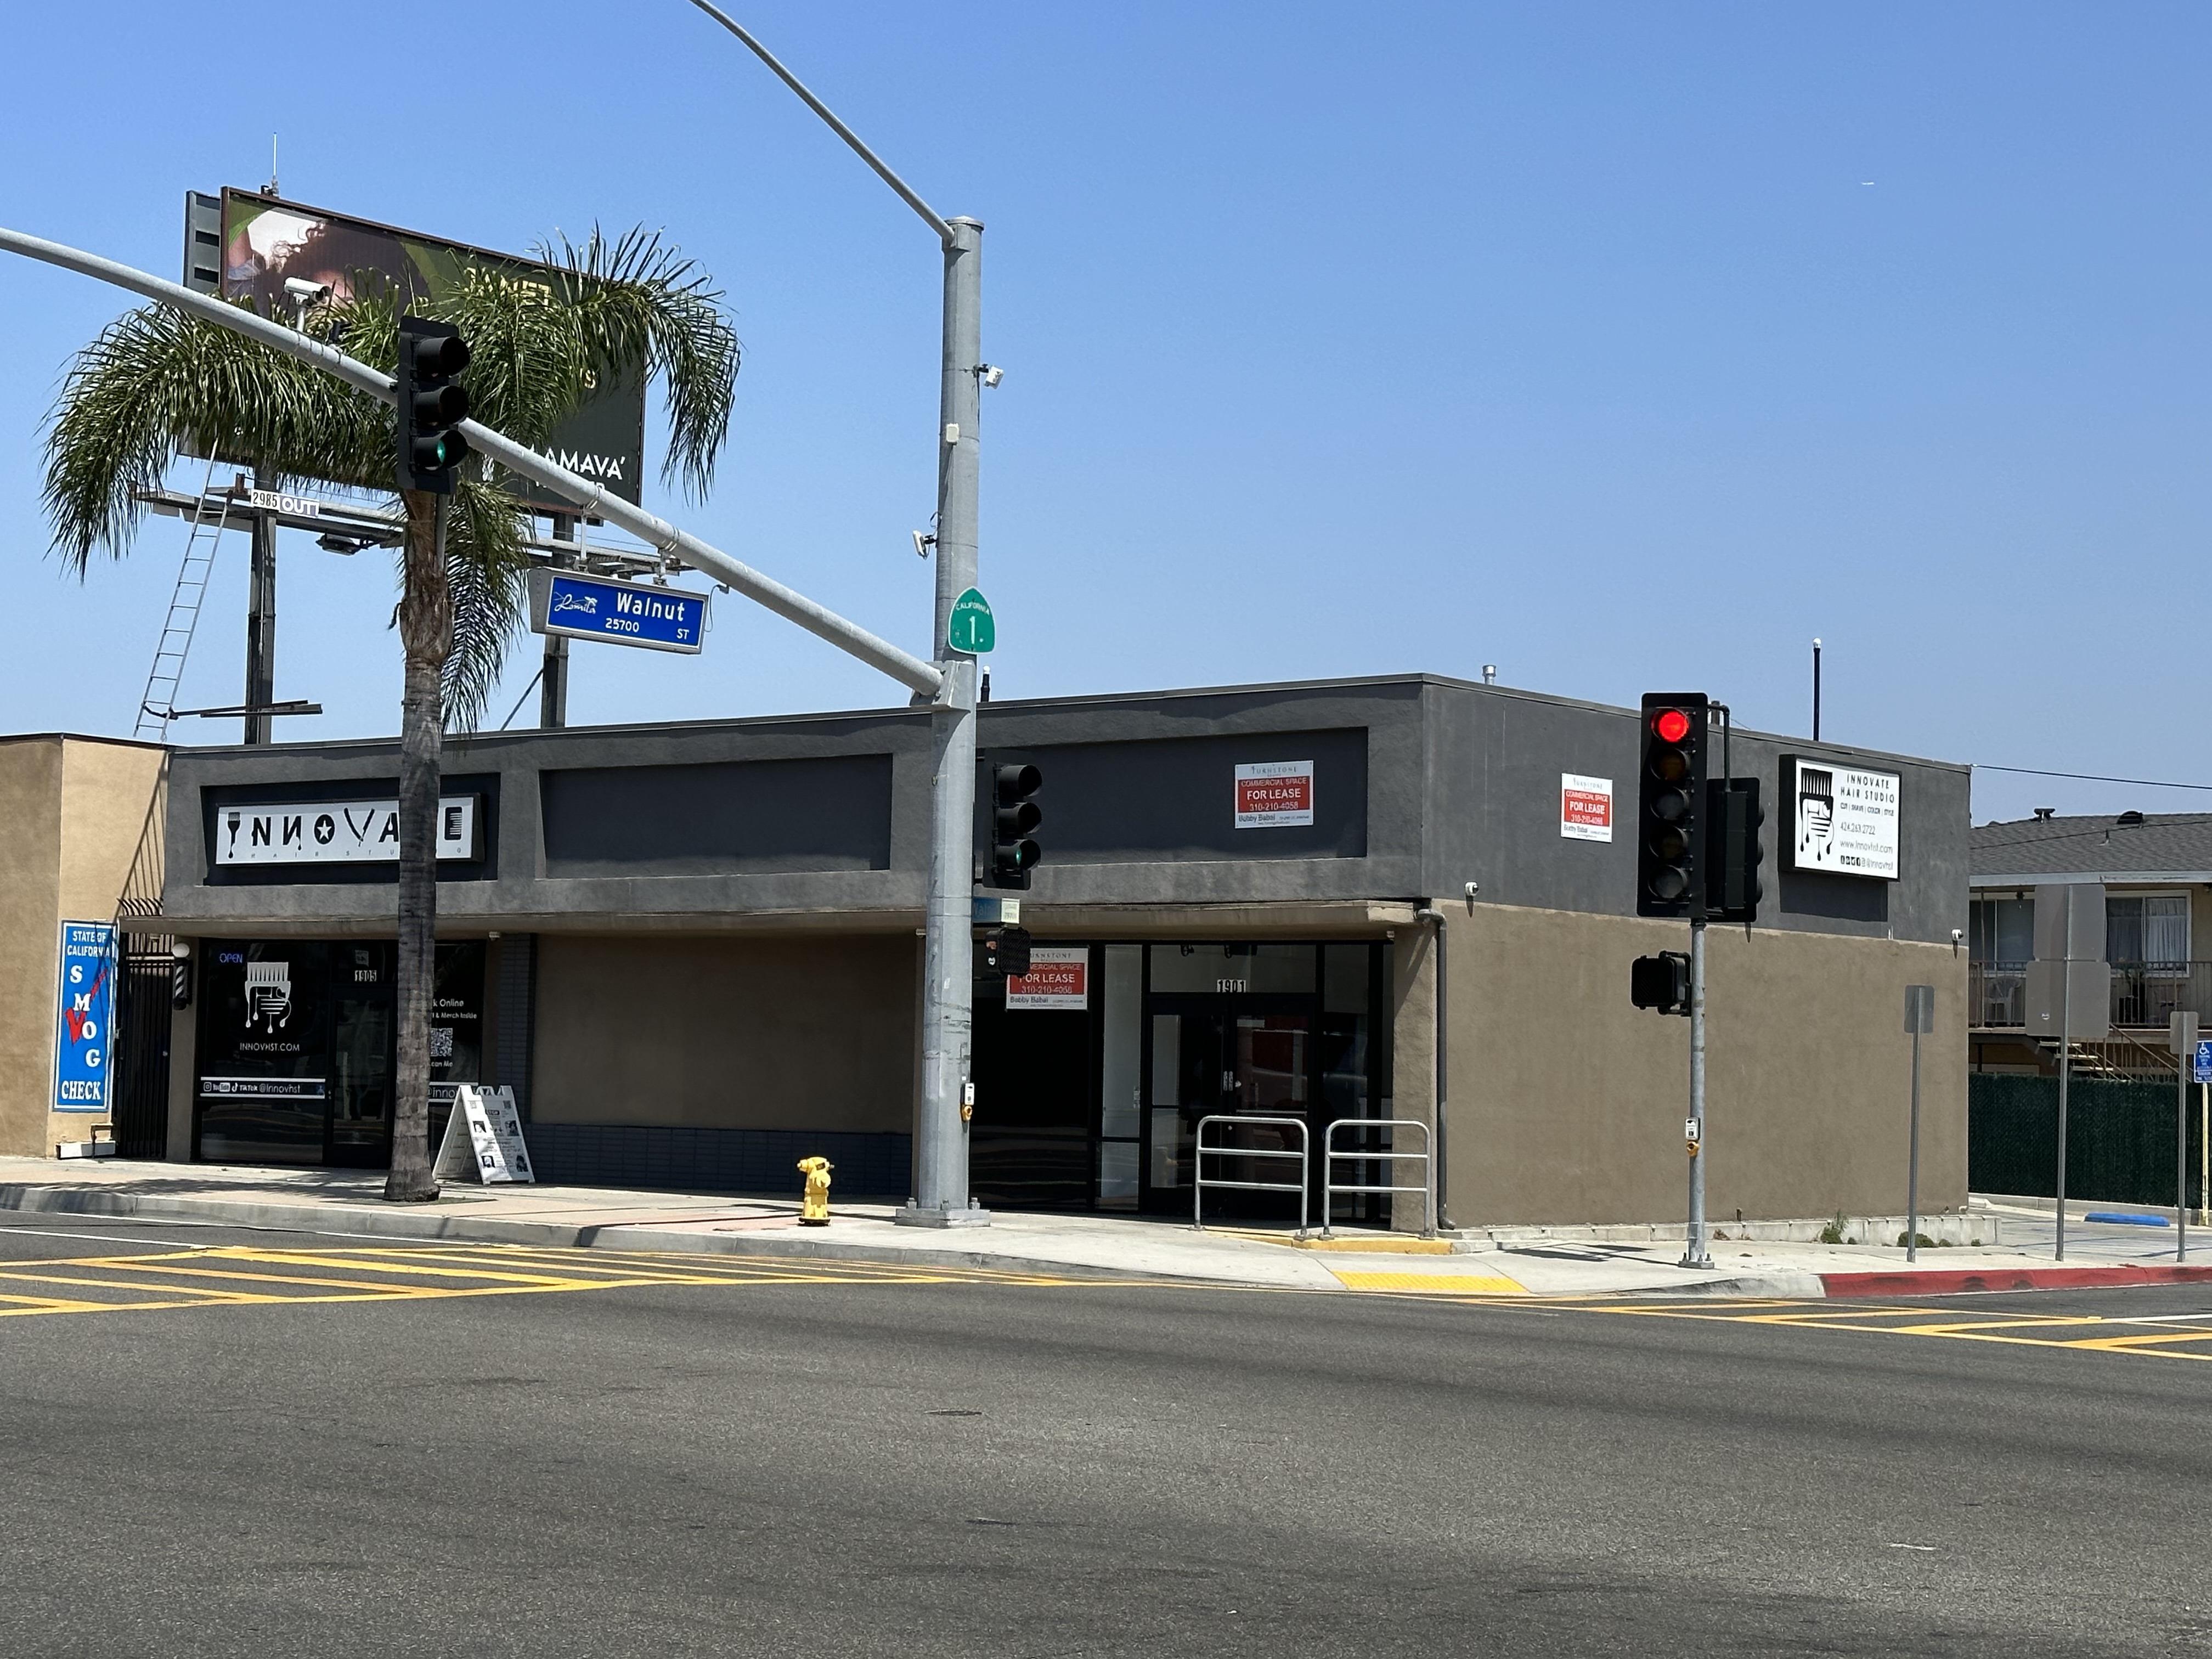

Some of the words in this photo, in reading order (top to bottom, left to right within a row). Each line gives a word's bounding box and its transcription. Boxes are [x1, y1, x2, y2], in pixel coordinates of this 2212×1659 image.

[253, 492, 278, 507] 2985
[554, 594, 597, 614] Lomita
[617, 592, 685, 622] Walnut
[956, 602, 990, 616] CALIFORNIA
[605, 618, 640, 632] 25700
[676, 628, 690, 640] ST
[969, 616, 975, 645] 1
[1251, 766, 1297, 775] TURNSTONE
[1241, 778, 1283, 787] COMMERCIAL
[1285, 777, 1307, 785] SPACE
[1847, 773, 1889, 789] INNOVATE
[1247, 790, 1267, 800] FOR
[1269, 788, 1301, 799] LEASE
[1565, 791, 1594, 801] COMMERCIAL
[1841, 787, 1860, 798] HAIR
[1865, 790, 1894, 803] STUDIO
[1249, 801, 1299, 811] 310-210-4058
[1570, 800, 1584, 811] FOR
[1584, 803, 1605, 814] LEASE
[228, 806, 462, 859] INNOVAE
[346, 848, 461, 857] STUO
[72, 930, 95, 943] STATE
[96, 931, 107, 943] OF
[67, 945, 110, 957] CALIFORNIA
[219, 953, 242, 963] OPEN
[355, 970, 375, 981] 1905
[1043, 973, 1075, 983] LEASE
[1217, 979, 1245, 993] 1901
[439, 998, 464, 1007] Online
[70, 964, 101, 1068] SMOG
[61, 1080, 101, 1101] CHECK
